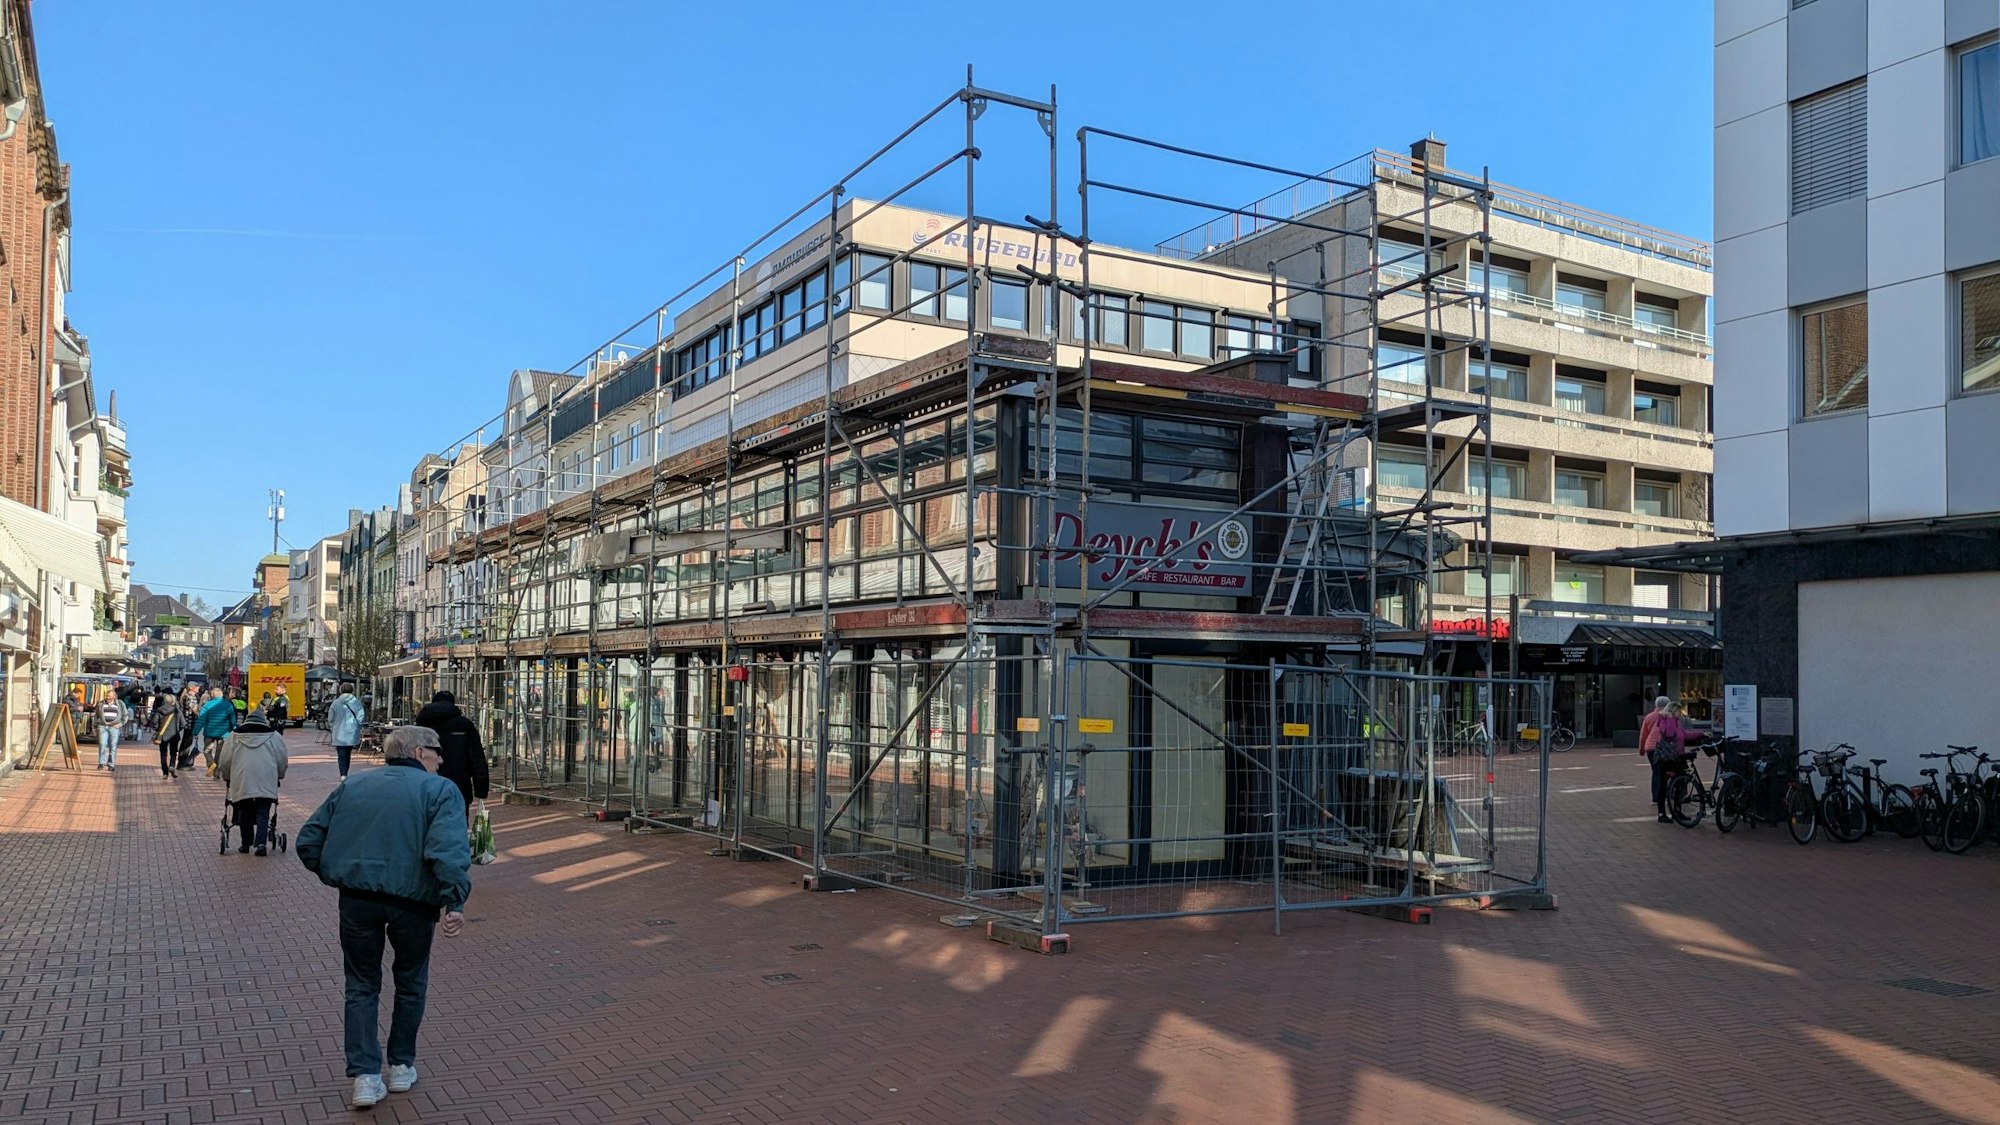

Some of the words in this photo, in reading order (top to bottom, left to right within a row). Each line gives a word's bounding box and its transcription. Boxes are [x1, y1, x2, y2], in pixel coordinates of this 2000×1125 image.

[1162, 573, 1216, 585] RESTAURANT
[1220, 576, 1238, 586] BAR
[260, 676, 294, 684] DHL
